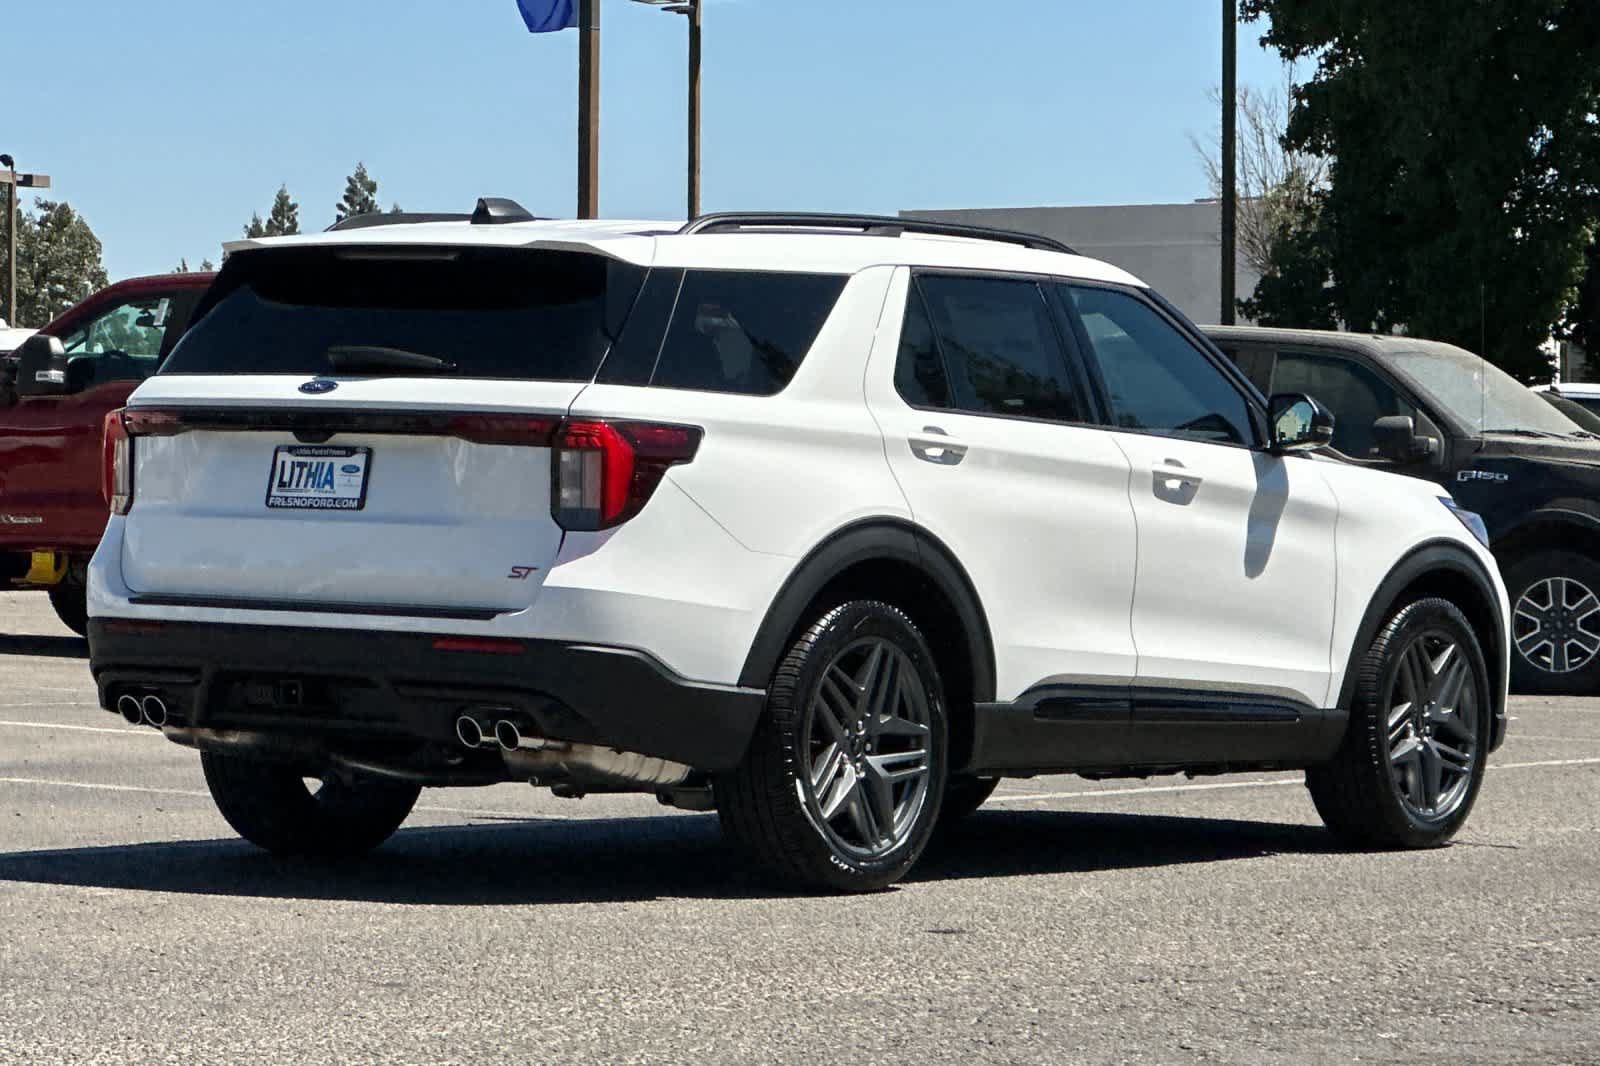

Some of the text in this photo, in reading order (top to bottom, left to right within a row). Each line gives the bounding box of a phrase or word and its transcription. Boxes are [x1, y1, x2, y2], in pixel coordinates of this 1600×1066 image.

[277, 460, 335, 490] LITHIA
[268, 496, 358, 509] FRESNOFORD.COM
[507, 566, 539, 580] ST
